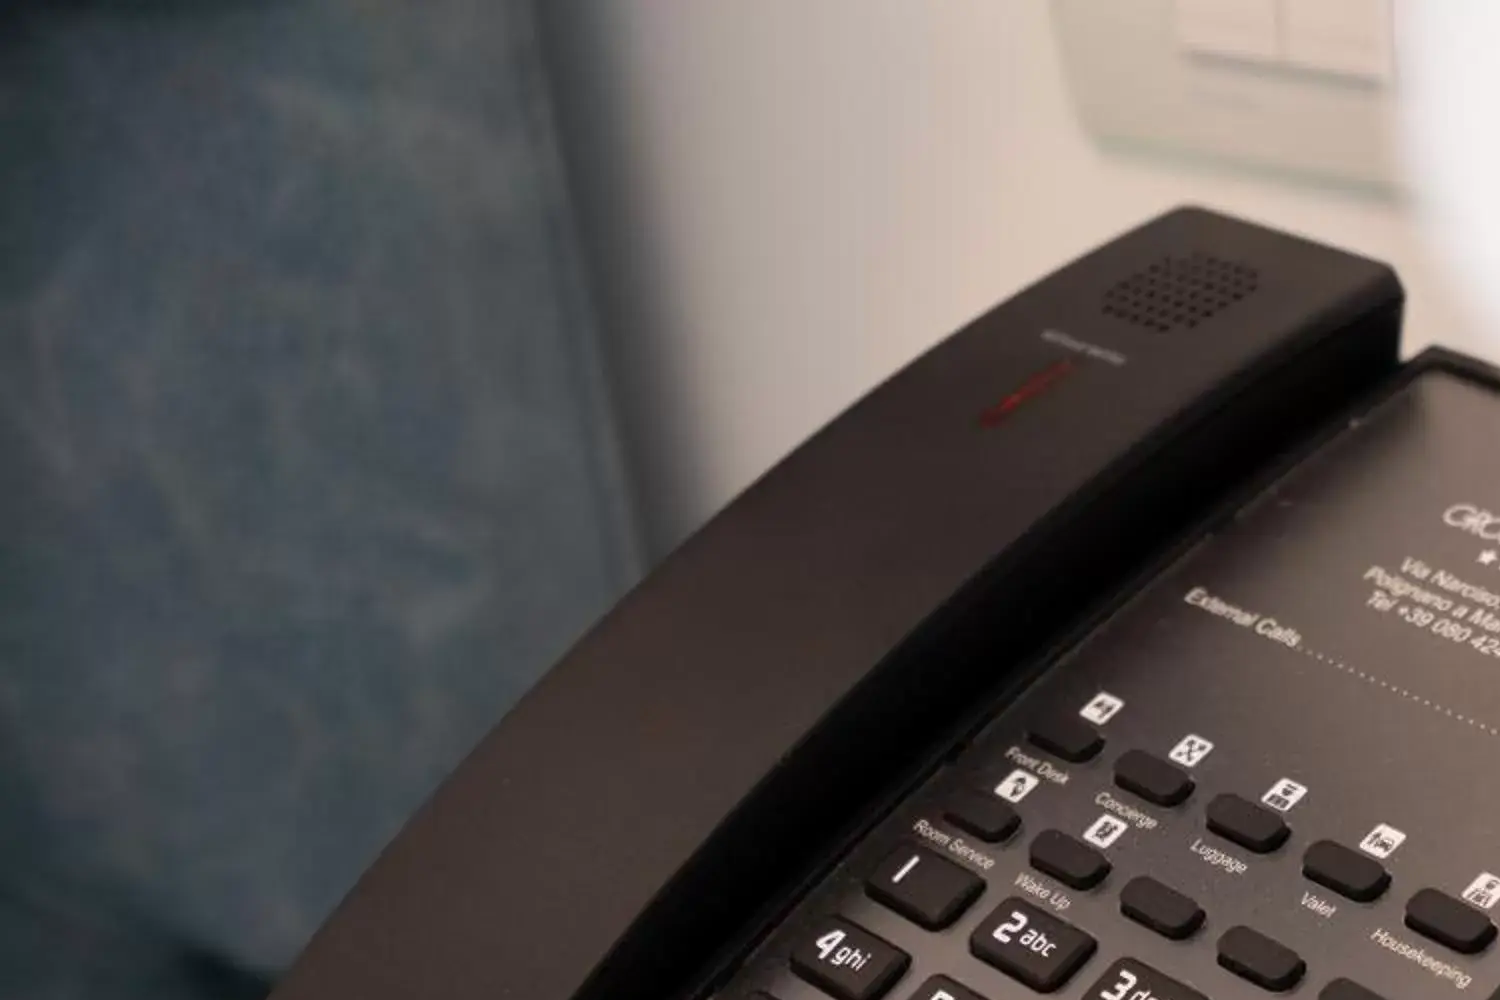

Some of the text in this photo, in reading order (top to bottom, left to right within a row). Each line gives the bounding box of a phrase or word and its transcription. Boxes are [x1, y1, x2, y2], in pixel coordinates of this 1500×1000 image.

[1184, 586, 1260, 627] External
[1365, 589, 1399, 612] Tel
[1398, 606, 1435, 627] +39
[1430, 618, 1473, 642] 080
[1452, 604, 1470, 619] a
[1005, 746, 1069, 784] Front Desk
[1095, 792, 1158, 829] Concierge
[913, 819, 995, 869] Room Service
[1190, 839, 1248, 875] Luggage
[1014, 872, 1071, 911] Wake Up
[1300, 892, 1337, 918] Valet
[1370, 928, 1473, 990] Housekeeping
